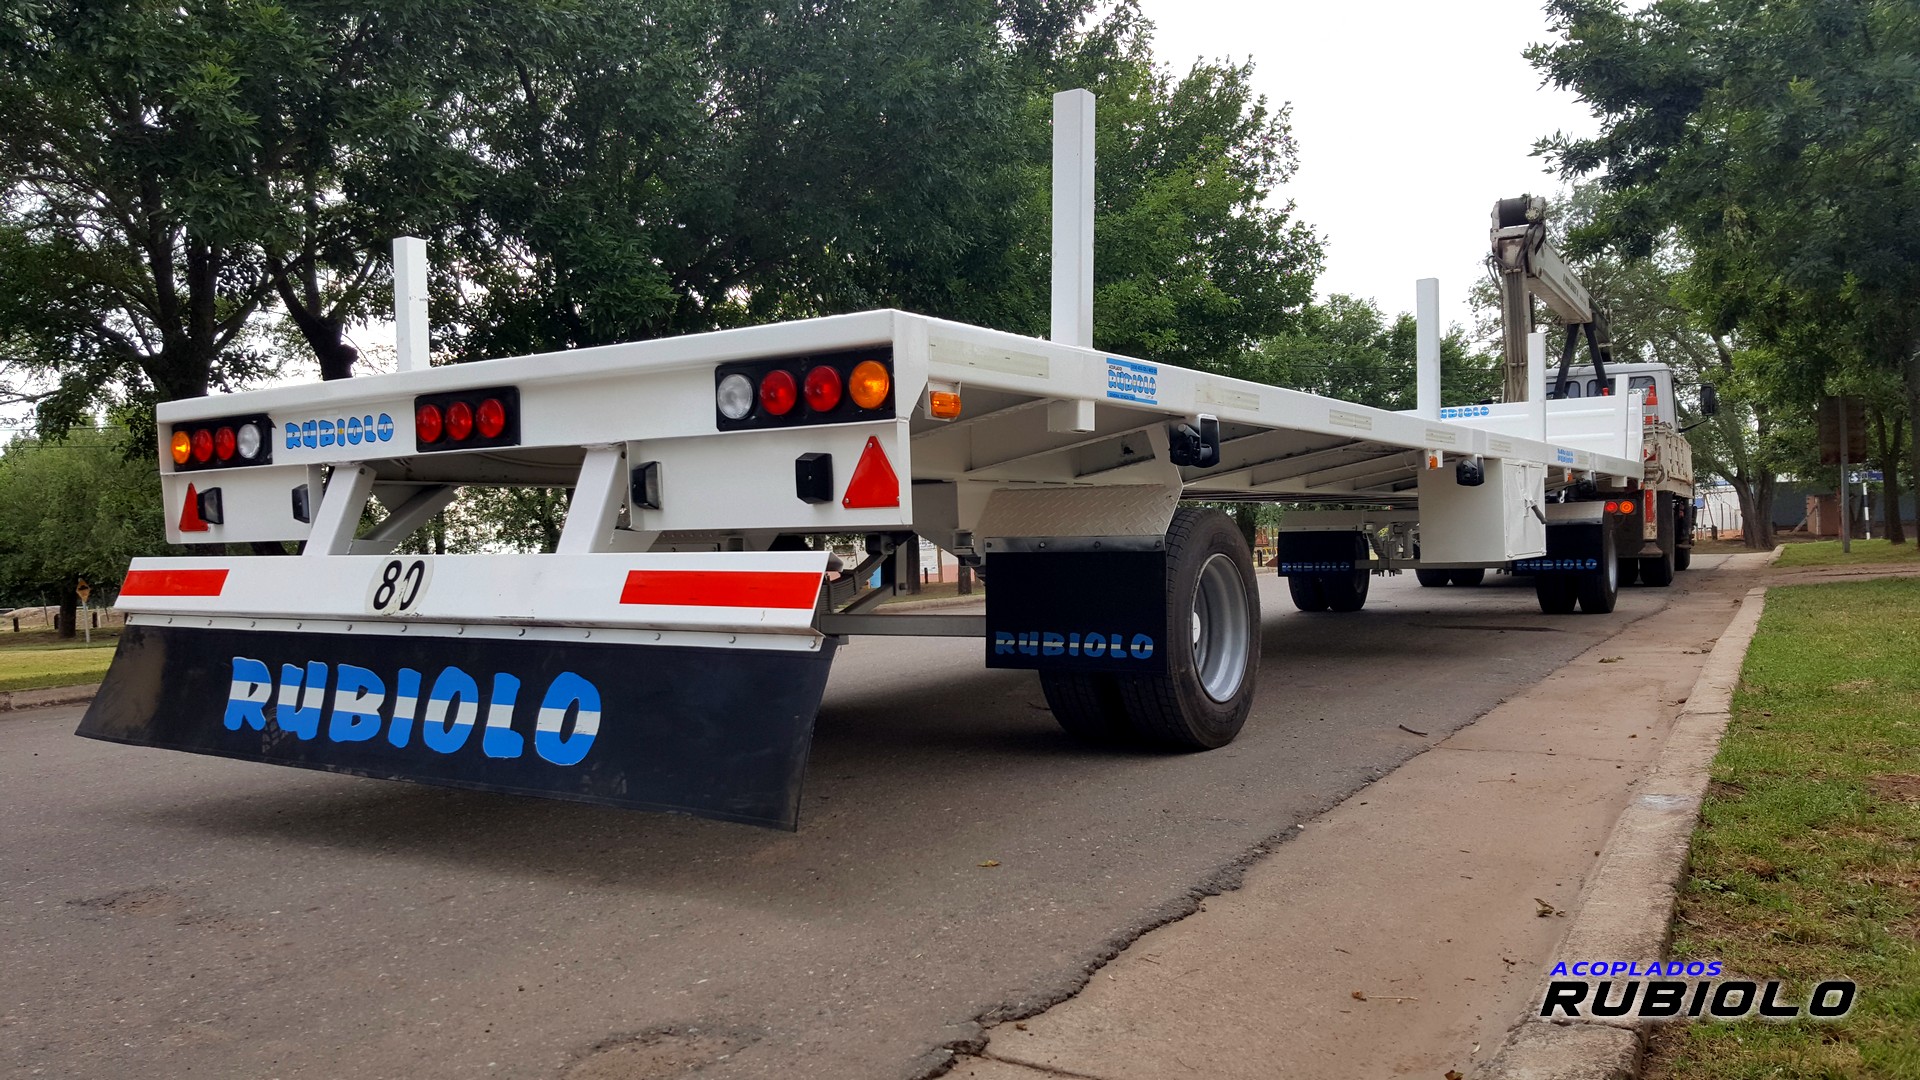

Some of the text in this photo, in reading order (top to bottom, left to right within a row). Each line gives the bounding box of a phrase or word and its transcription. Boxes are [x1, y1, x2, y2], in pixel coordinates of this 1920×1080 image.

[1108, 369, 1156, 396] RUBIOLO
[1440, 406, 1489, 419] UBIOLO
[285, 413, 394, 450] RUBIOLO
[1281, 562, 1350, 572] RUBIOLO
[1516, 558, 1597, 571] RUBIOLO
[373, 560, 425, 610] 80
[995, 631, 1154, 660] RUBIOLO
[223, 656, 601, 766] RUBIOLO
